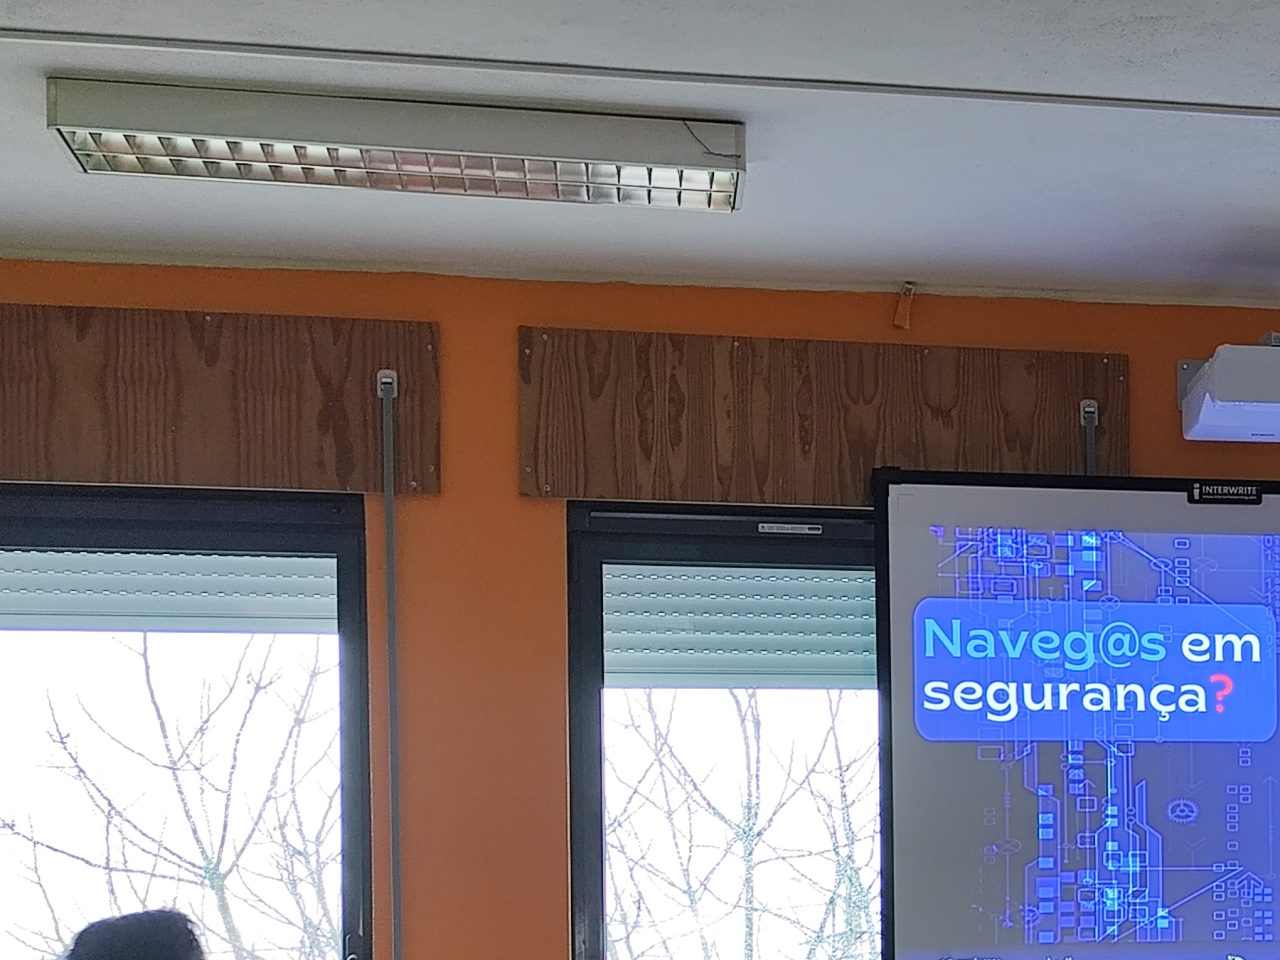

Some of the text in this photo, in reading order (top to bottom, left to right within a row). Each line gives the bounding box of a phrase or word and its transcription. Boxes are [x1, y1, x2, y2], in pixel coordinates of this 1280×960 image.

[1202, 485, 1257, 495] INTERWRITE
[924, 618, 1262, 671] Naveg@s em
[922, 673, 1234, 722] segurança?
